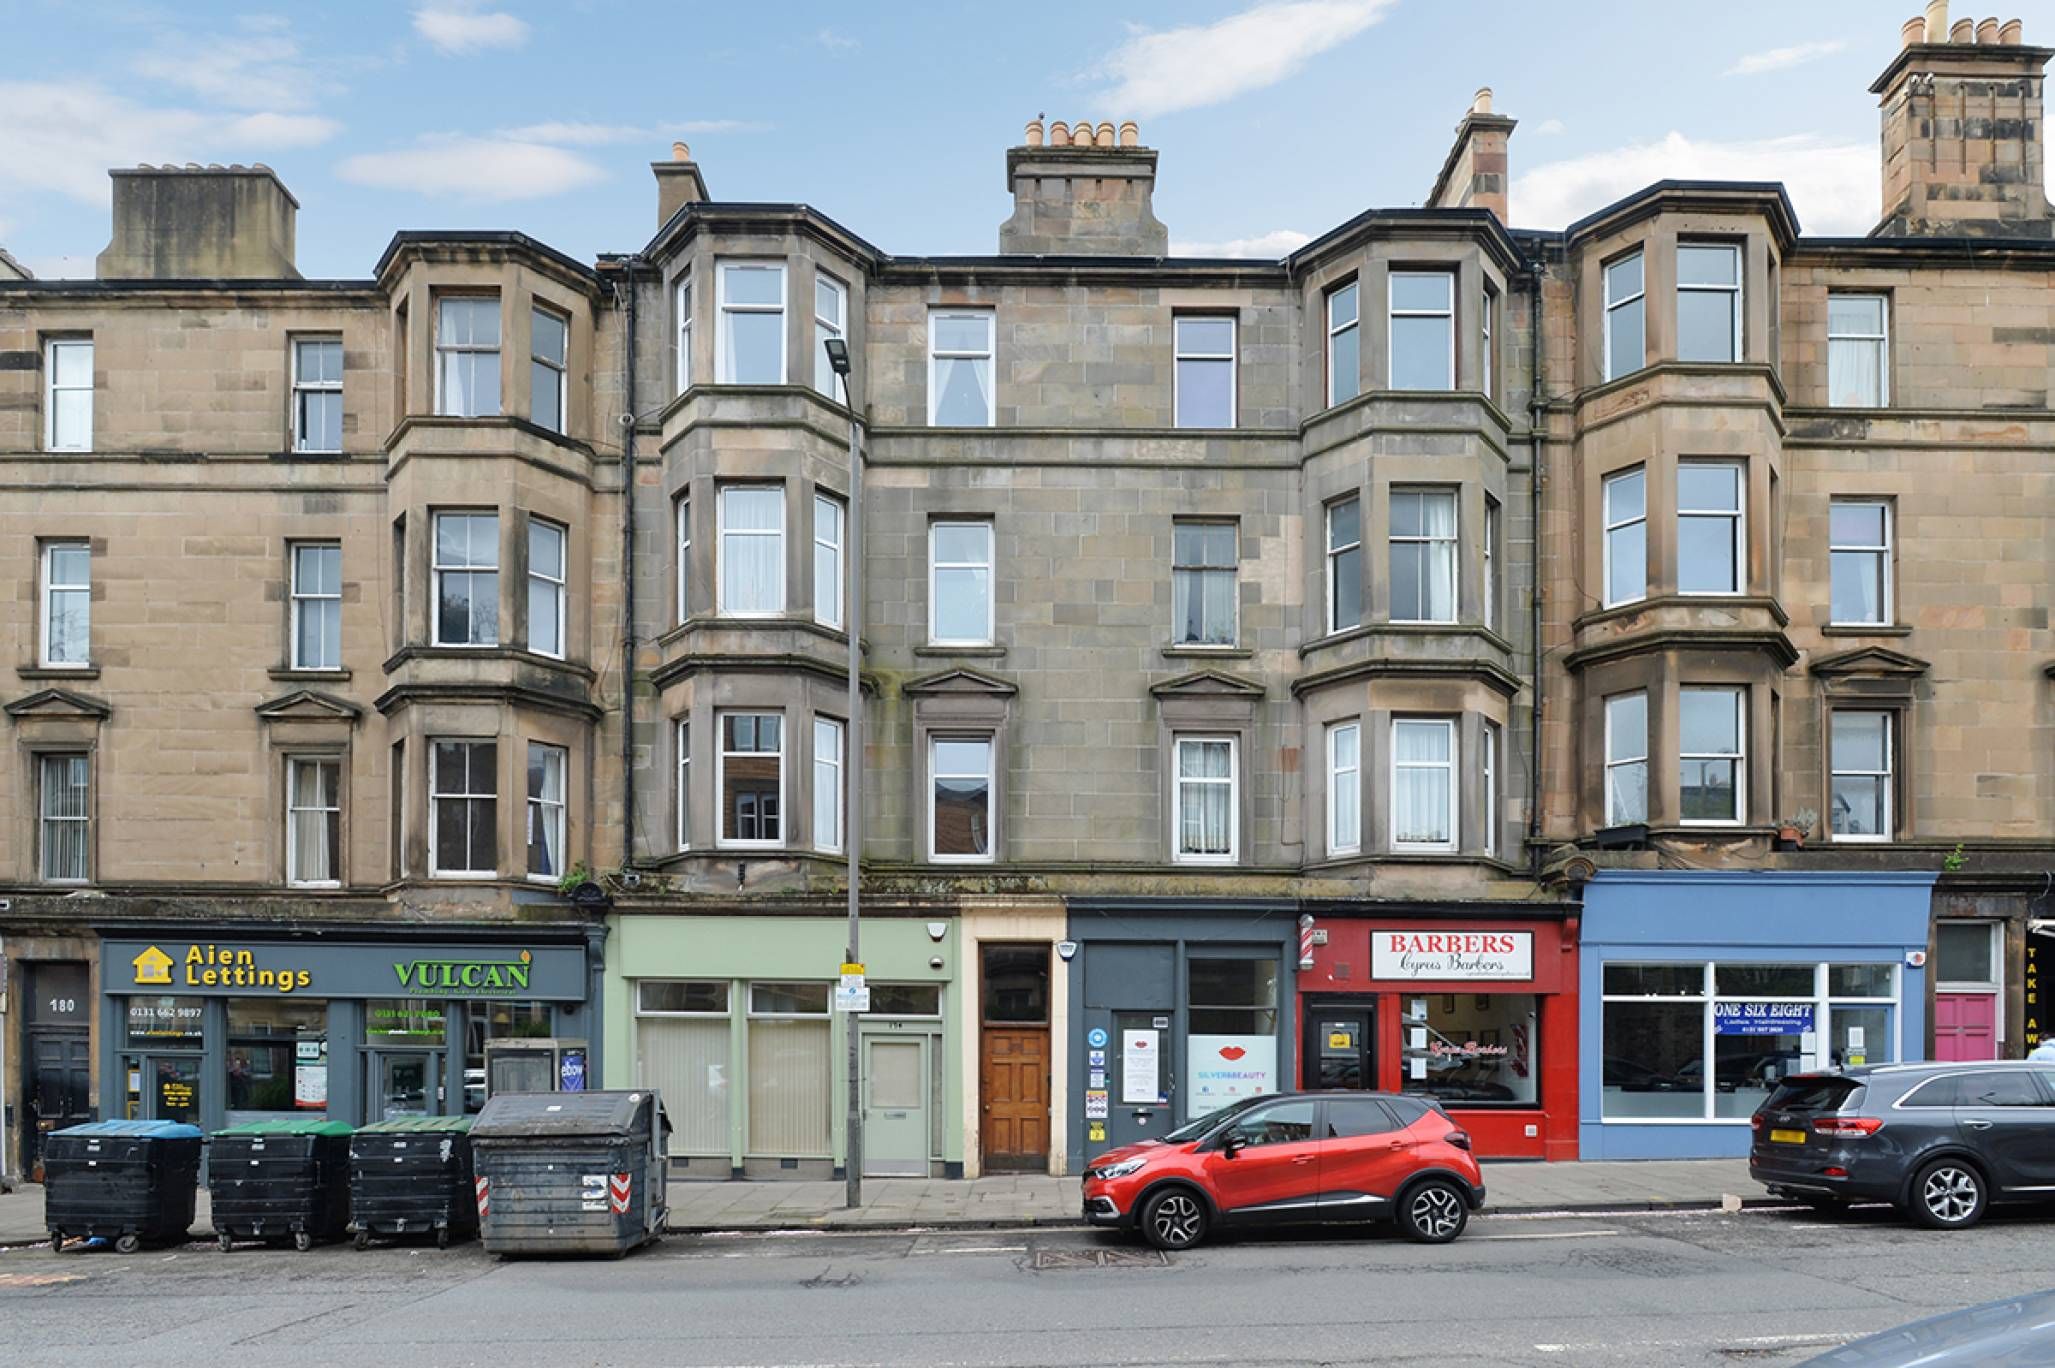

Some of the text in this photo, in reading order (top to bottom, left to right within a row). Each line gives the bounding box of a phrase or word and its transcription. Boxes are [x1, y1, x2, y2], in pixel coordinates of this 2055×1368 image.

[1390, 934, 1515, 953] BARBERS
[185, 944, 252, 965] Aien
[1400, 953, 1504, 976] Cyrus Barbers
[186, 965, 311, 993] Lettings
[393, 960, 530, 988] VULCAN
[2027, 948, 2037, 1004] TAKE
[50, 999, 75, 1013] 180
[129, 1008, 154, 1018] 0131
[157, 1008, 175, 1018] 662
[1714, 1003, 1813, 1018] ONE SIX EIGHT
